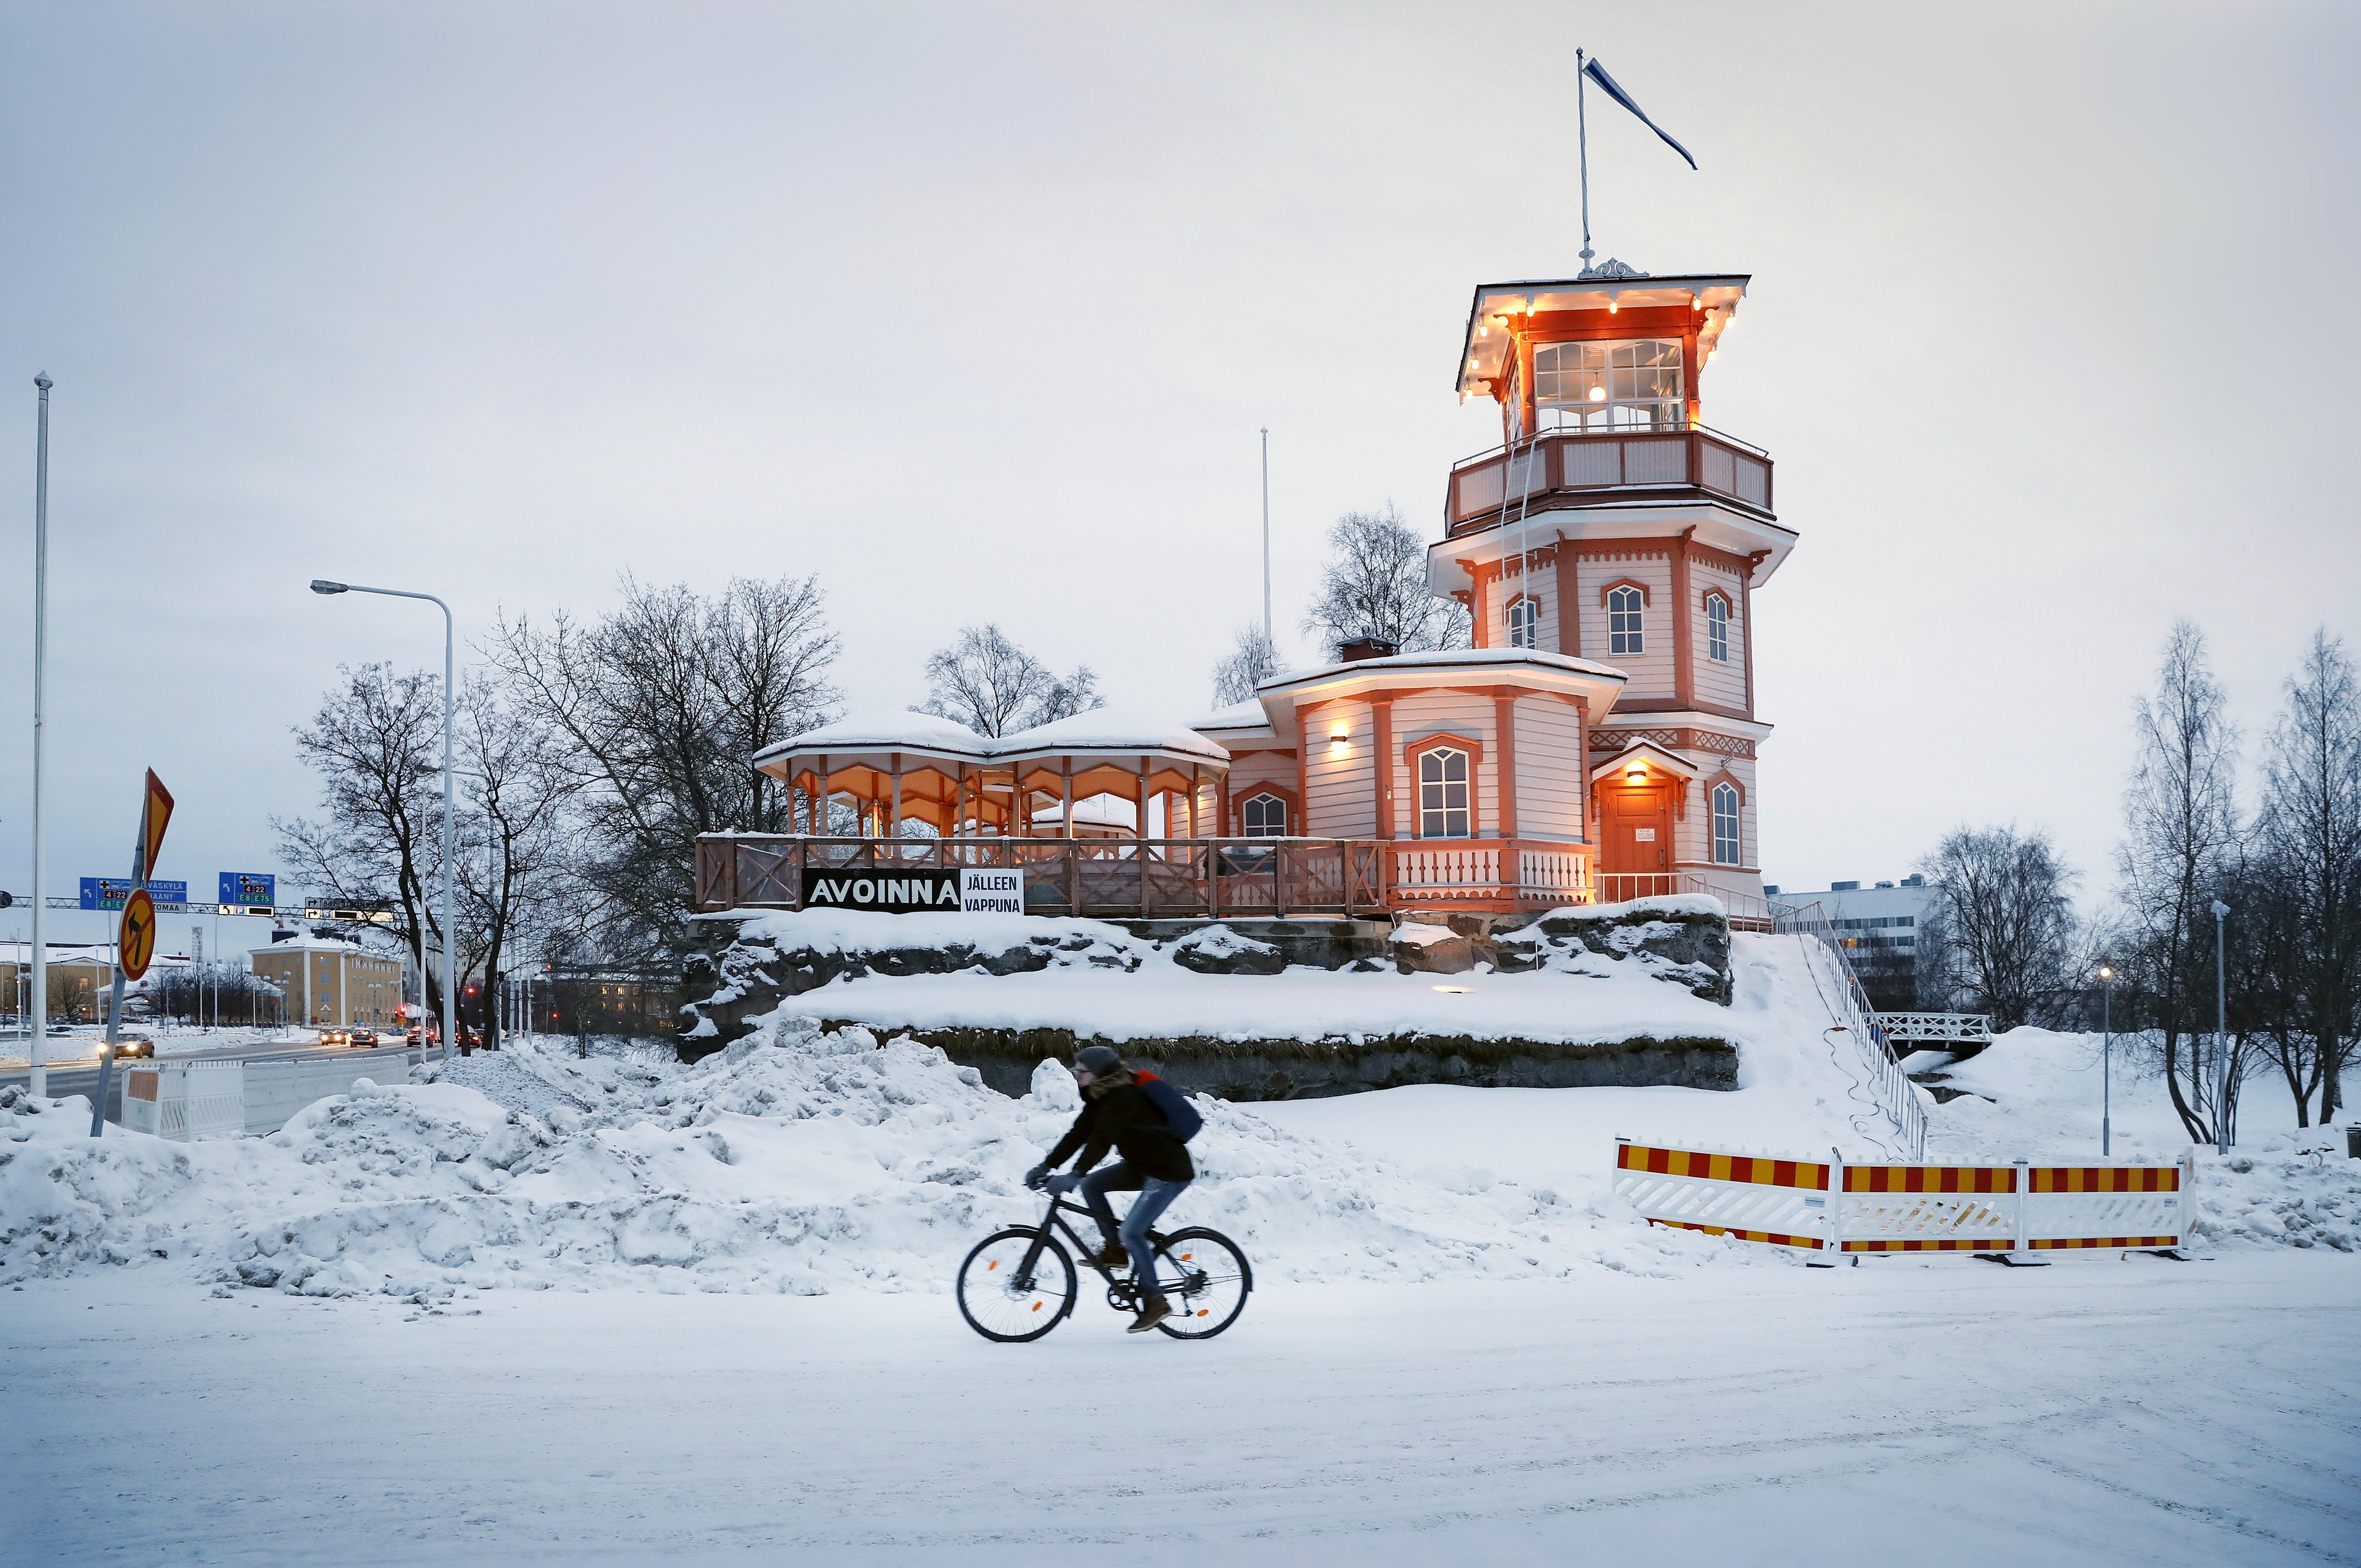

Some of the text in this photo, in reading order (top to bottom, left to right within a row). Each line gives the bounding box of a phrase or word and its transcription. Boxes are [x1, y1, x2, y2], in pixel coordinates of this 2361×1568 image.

[967, 874, 1016, 890] JÄLLEEN
[809, 879, 960, 904] AVOINNA
[964, 899, 1021, 913] VAPPUNA
